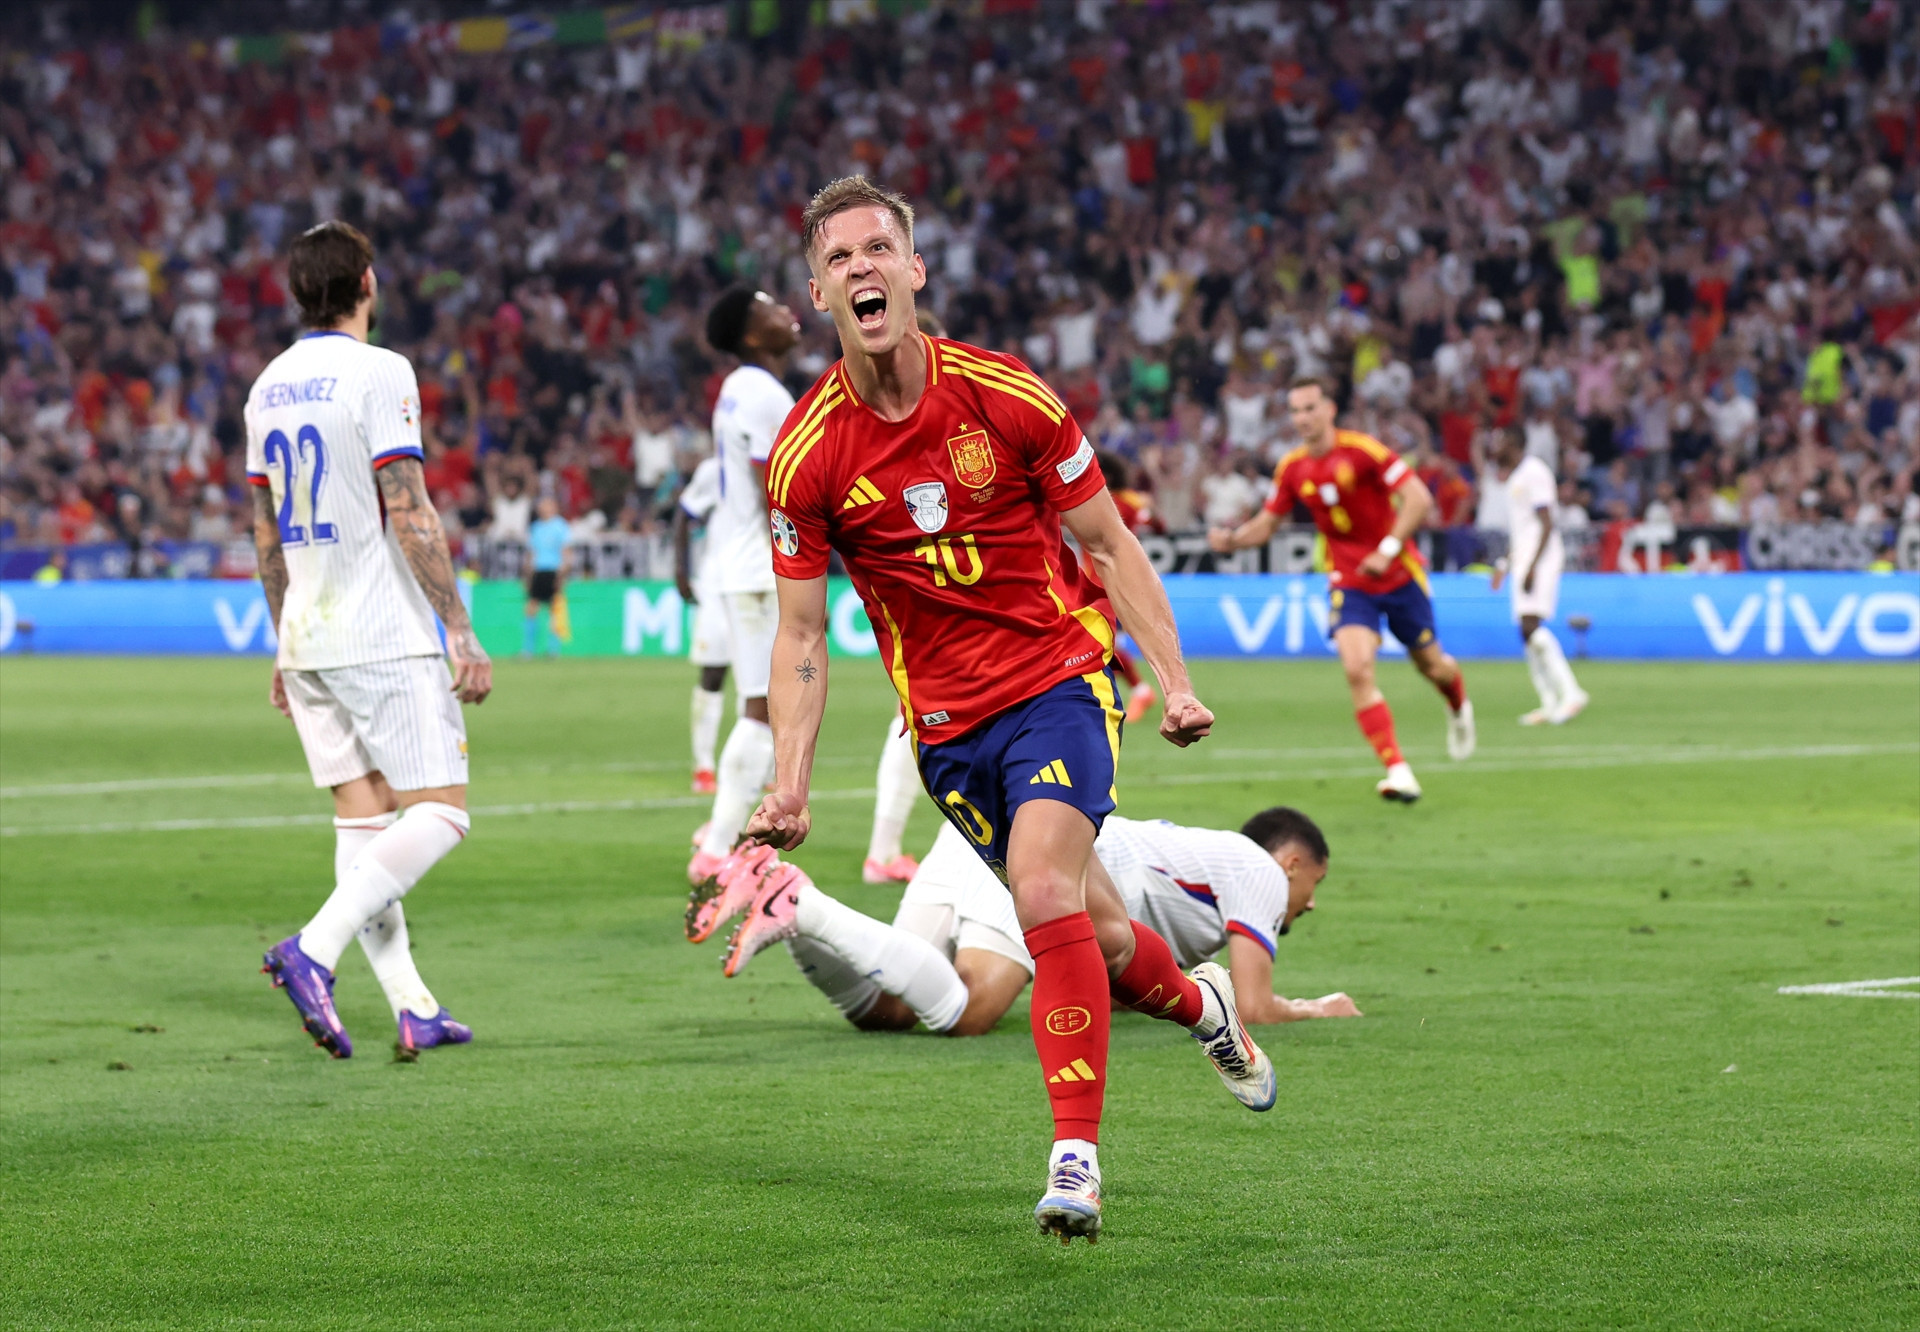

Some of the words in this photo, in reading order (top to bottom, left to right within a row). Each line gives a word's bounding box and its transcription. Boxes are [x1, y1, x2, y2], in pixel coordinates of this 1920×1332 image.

[264, 424, 339, 549] 22
[915, 533, 984, 587] 10
[1691, 577, 1920, 655] vivo
